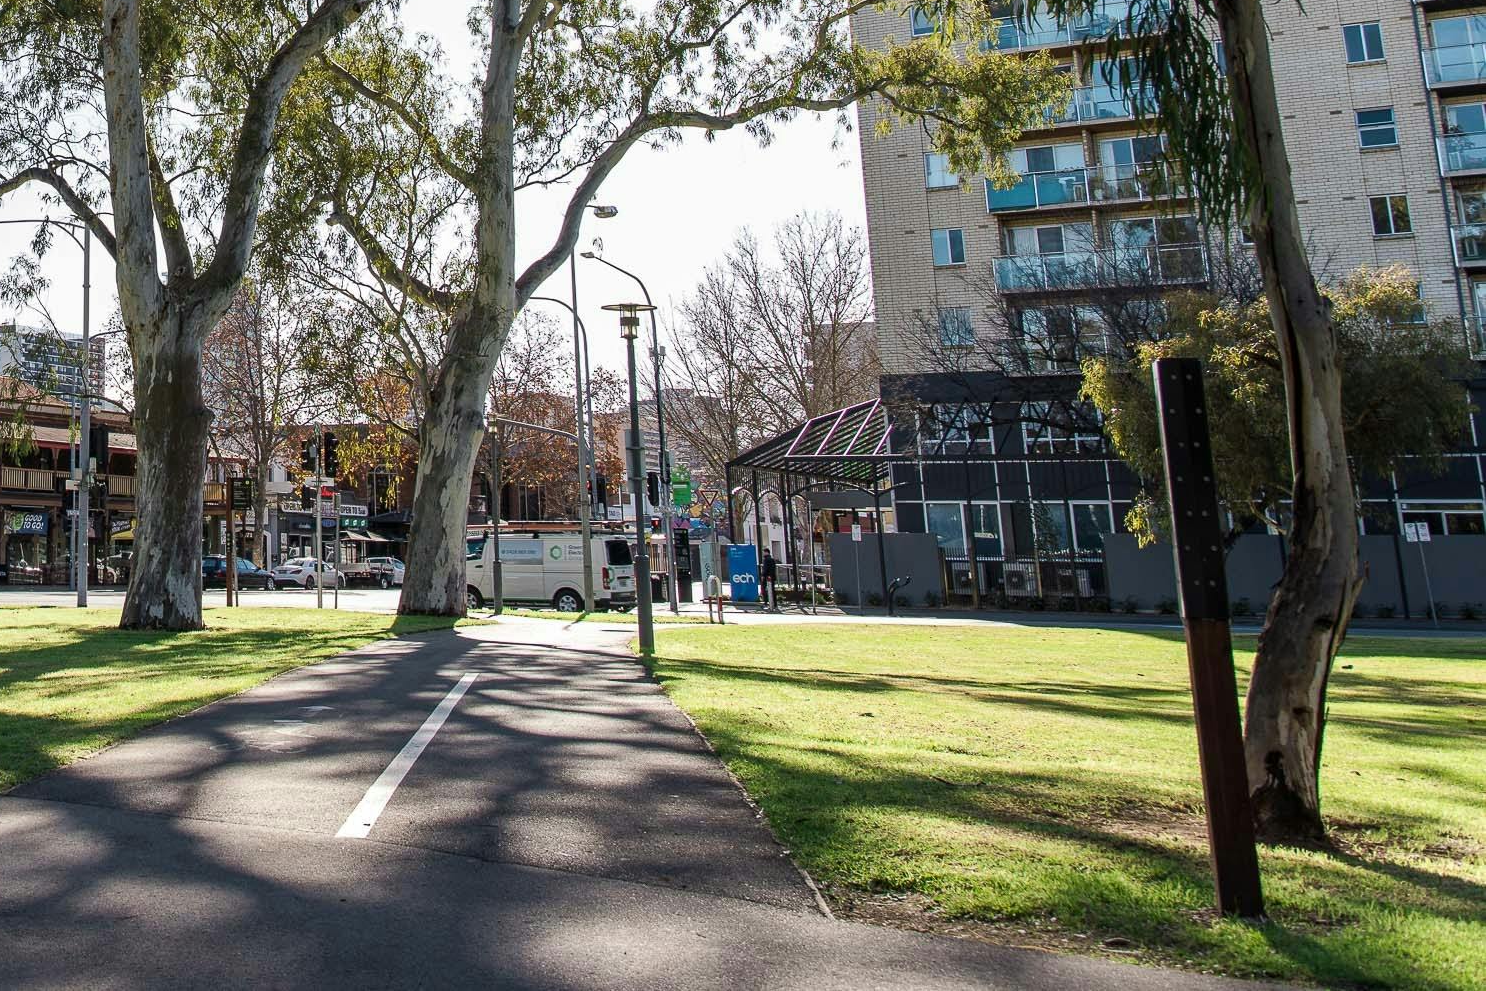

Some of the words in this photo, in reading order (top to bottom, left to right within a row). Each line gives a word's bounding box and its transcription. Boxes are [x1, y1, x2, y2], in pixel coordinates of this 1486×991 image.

[24, 514, 43, 522] GOOD
[23, 521, 32, 529] TO
[32, 521, 44, 530] GO!
[732, 572, 755, 584] ech
